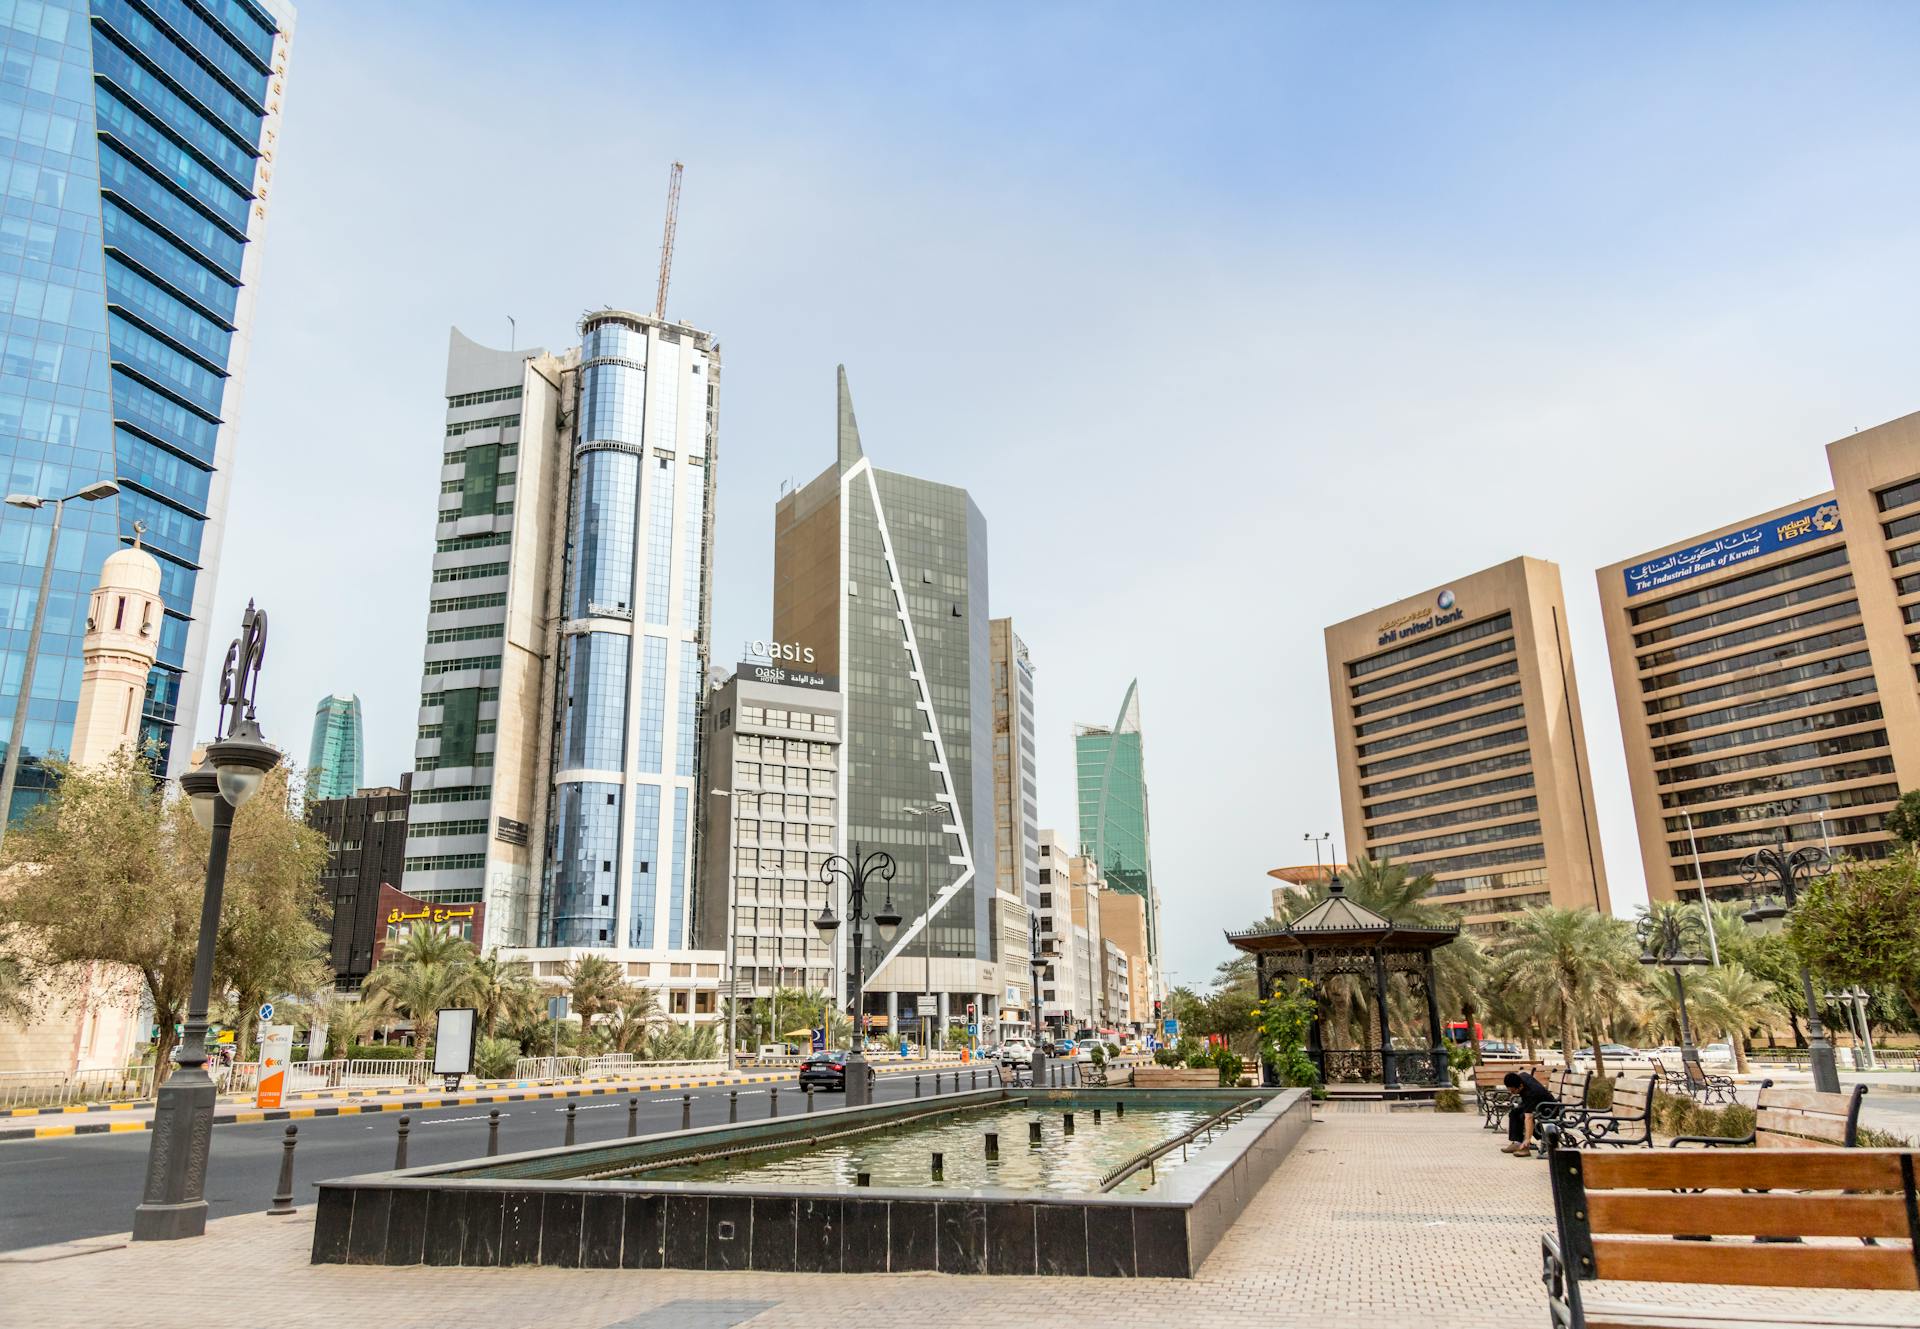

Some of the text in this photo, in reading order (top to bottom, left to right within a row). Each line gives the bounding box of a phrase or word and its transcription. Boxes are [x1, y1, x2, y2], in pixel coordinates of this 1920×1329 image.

[255, 27, 290, 220] WARBA TOWER
[1778, 525, 1812, 542] IBK
[1636, 545, 1760, 591] The Industrial Bank of Kuwait
[1378, 629, 1397, 646] ahli
[1399, 617, 1434, 638] united
[1435, 607, 1464, 627] bank
[760, 676, 780, 684] HOTEL
[791, 674, 824, 685] فندق الواحة
[387, 904, 475, 923] برج شرق
